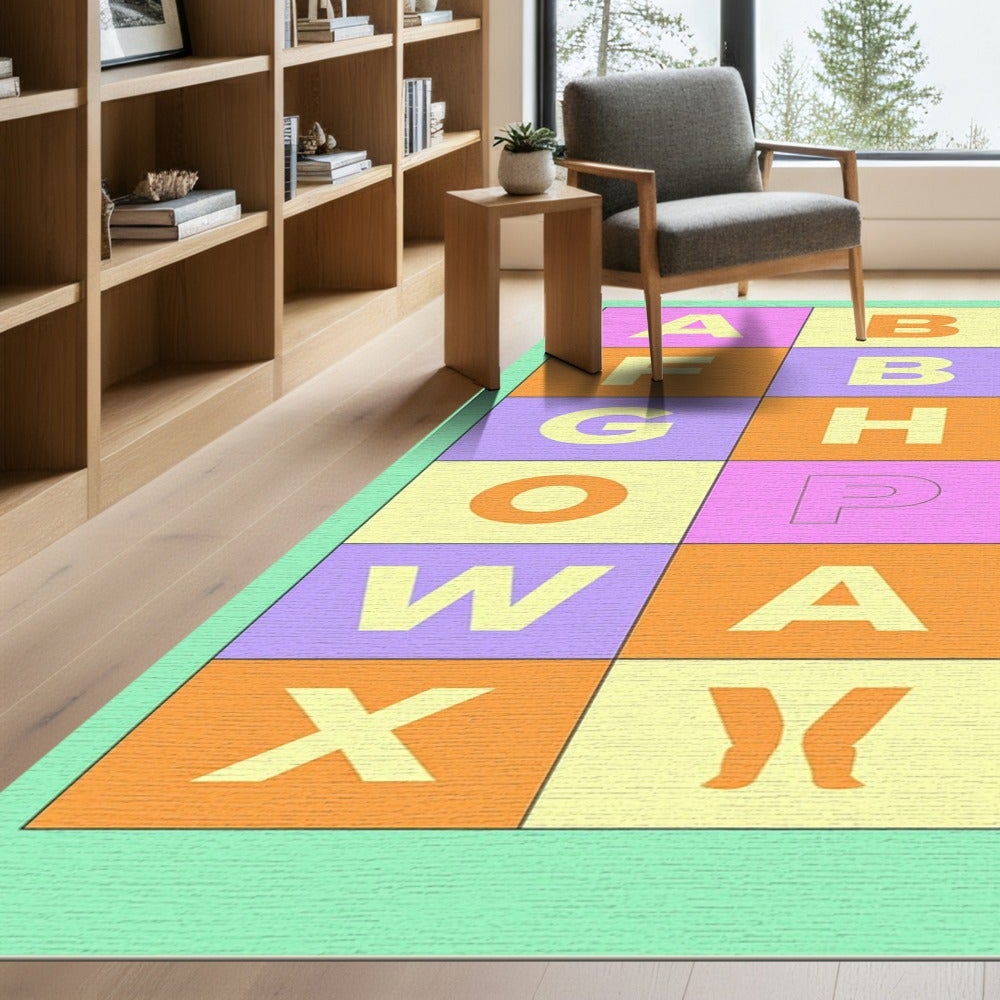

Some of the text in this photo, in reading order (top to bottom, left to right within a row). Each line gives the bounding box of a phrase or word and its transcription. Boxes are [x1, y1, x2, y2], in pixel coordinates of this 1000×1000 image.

[628, 314, 743, 338] A
[866, 314, 959, 338] B
[601, 356, 716, 385] F
[847, 356, 955, 385] B
[539, 407, 673, 444] G
[821, 407, 947, 444] H
[469, 474, 628, 524] O
[789, 474, 941, 525] P
[358, 565, 614, 631] W
[727, 565, 929, 631] A
[190, 687, 496, 782] X
